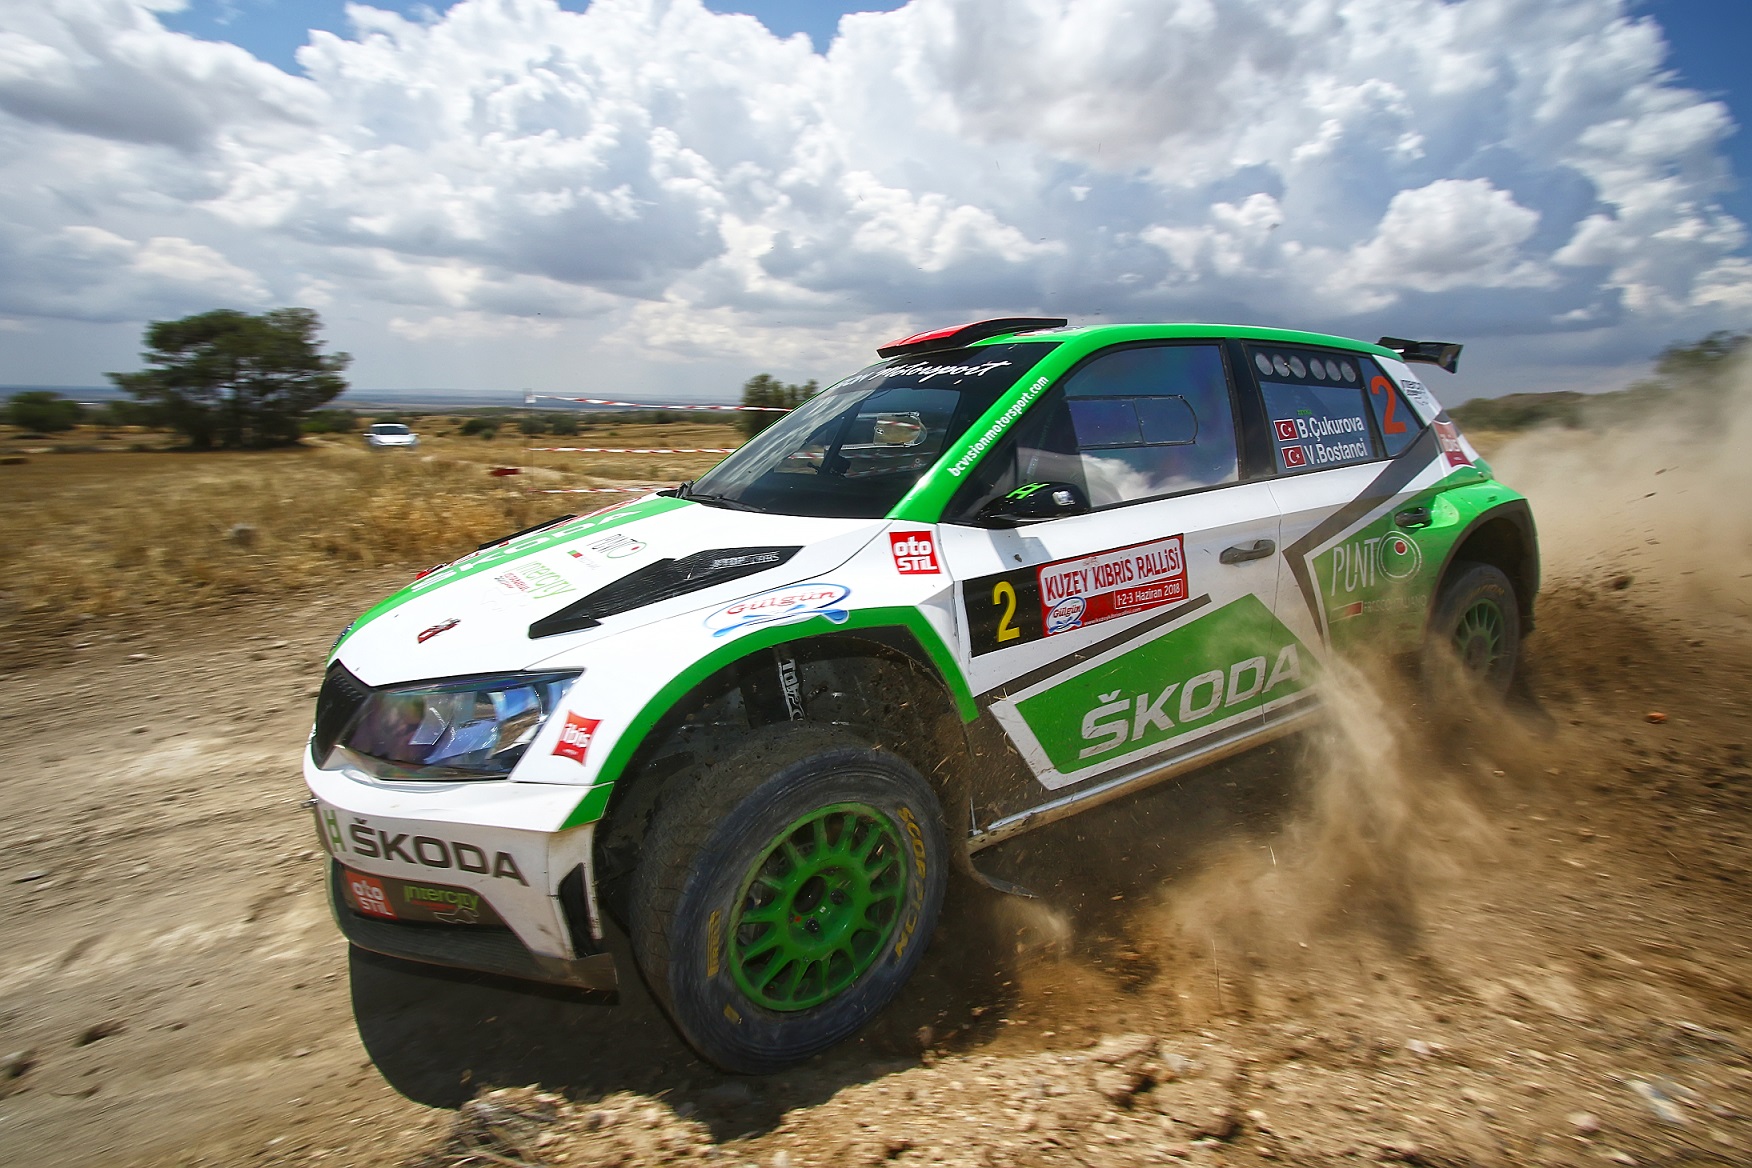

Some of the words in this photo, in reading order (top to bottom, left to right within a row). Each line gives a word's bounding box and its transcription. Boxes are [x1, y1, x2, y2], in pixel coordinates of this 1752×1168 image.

[1370, 375, 1407, 435] 2
[947, 374, 1050, 478] bcvisionmotorsport.com
[1296, 416, 1365, 443] B.Çukurova
[1303, 437, 1368, 465] V.Bostanci
[893, 535, 933, 557] oto
[1043, 568, 1089, 602] KUZEY
[1134, 586, 1163, 604] Haziran
[1163, 582, 1181, 598] 2018
[991, 580, 1021, 643] 2
[1078, 642, 1302, 760] ŠKODA
[349, 816, 530, 887] ŠKODA
[352, 879, 385, 901] oto
